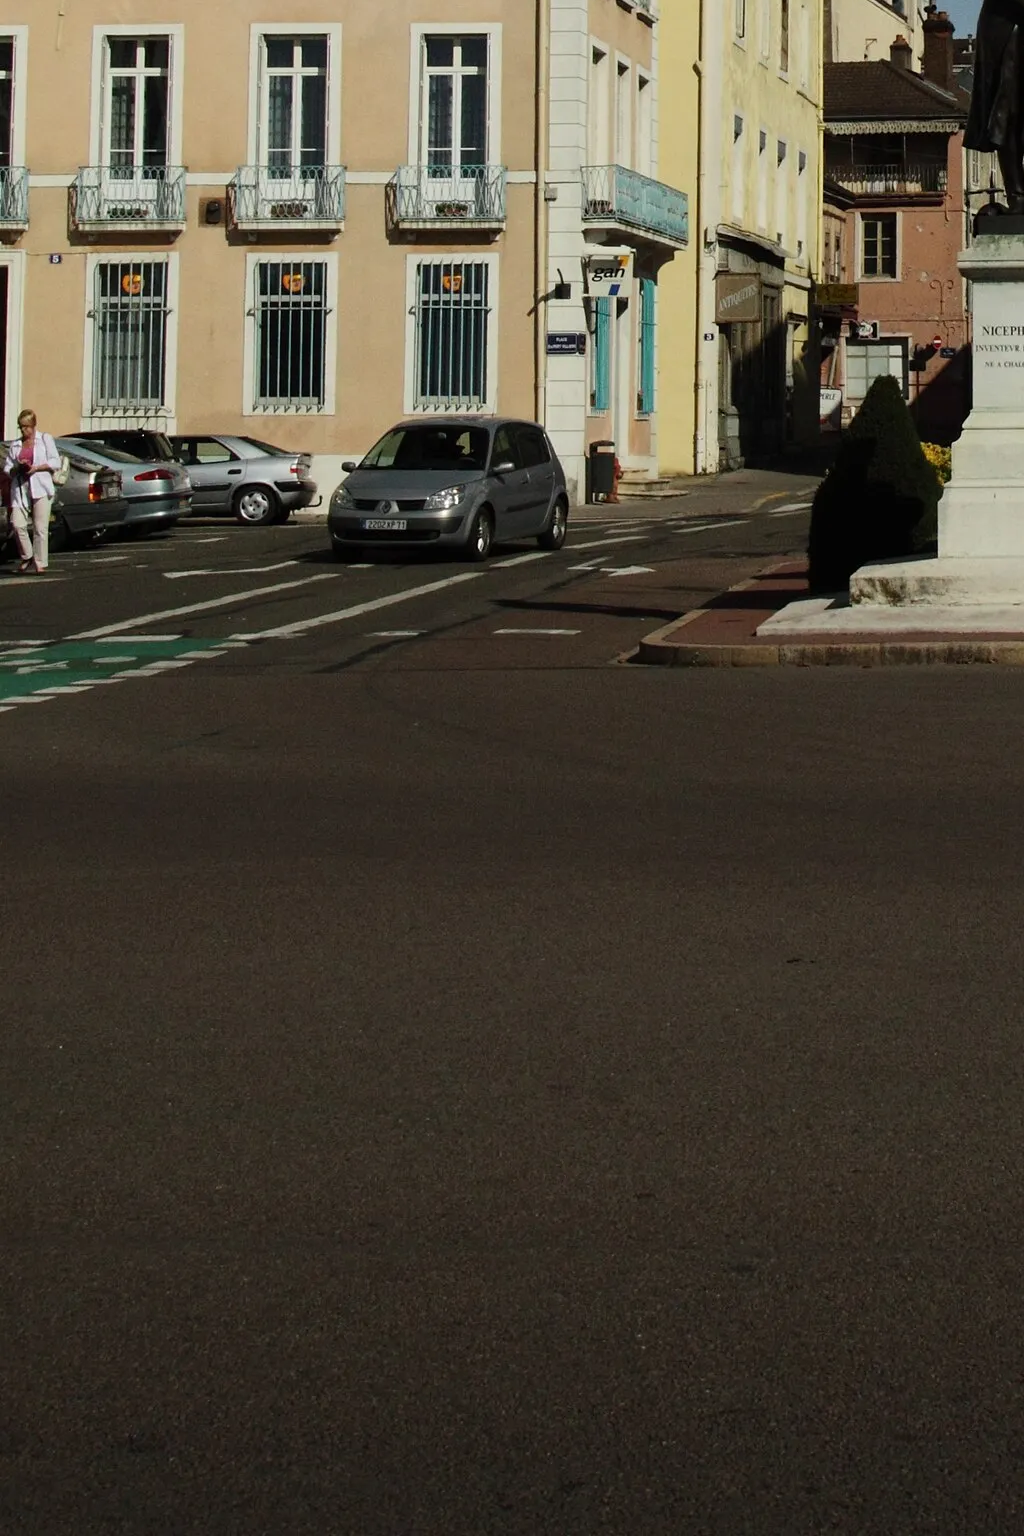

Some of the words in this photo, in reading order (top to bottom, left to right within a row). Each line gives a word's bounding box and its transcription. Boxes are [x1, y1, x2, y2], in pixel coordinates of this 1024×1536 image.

[53, 255, 60, 263] 5
[591, 267, 625, 282] gan
[976, 344, 1020, 353] INVENTEVR
[368, 520, 386, 529] 2202
[397, 520, 405, 529] 71
